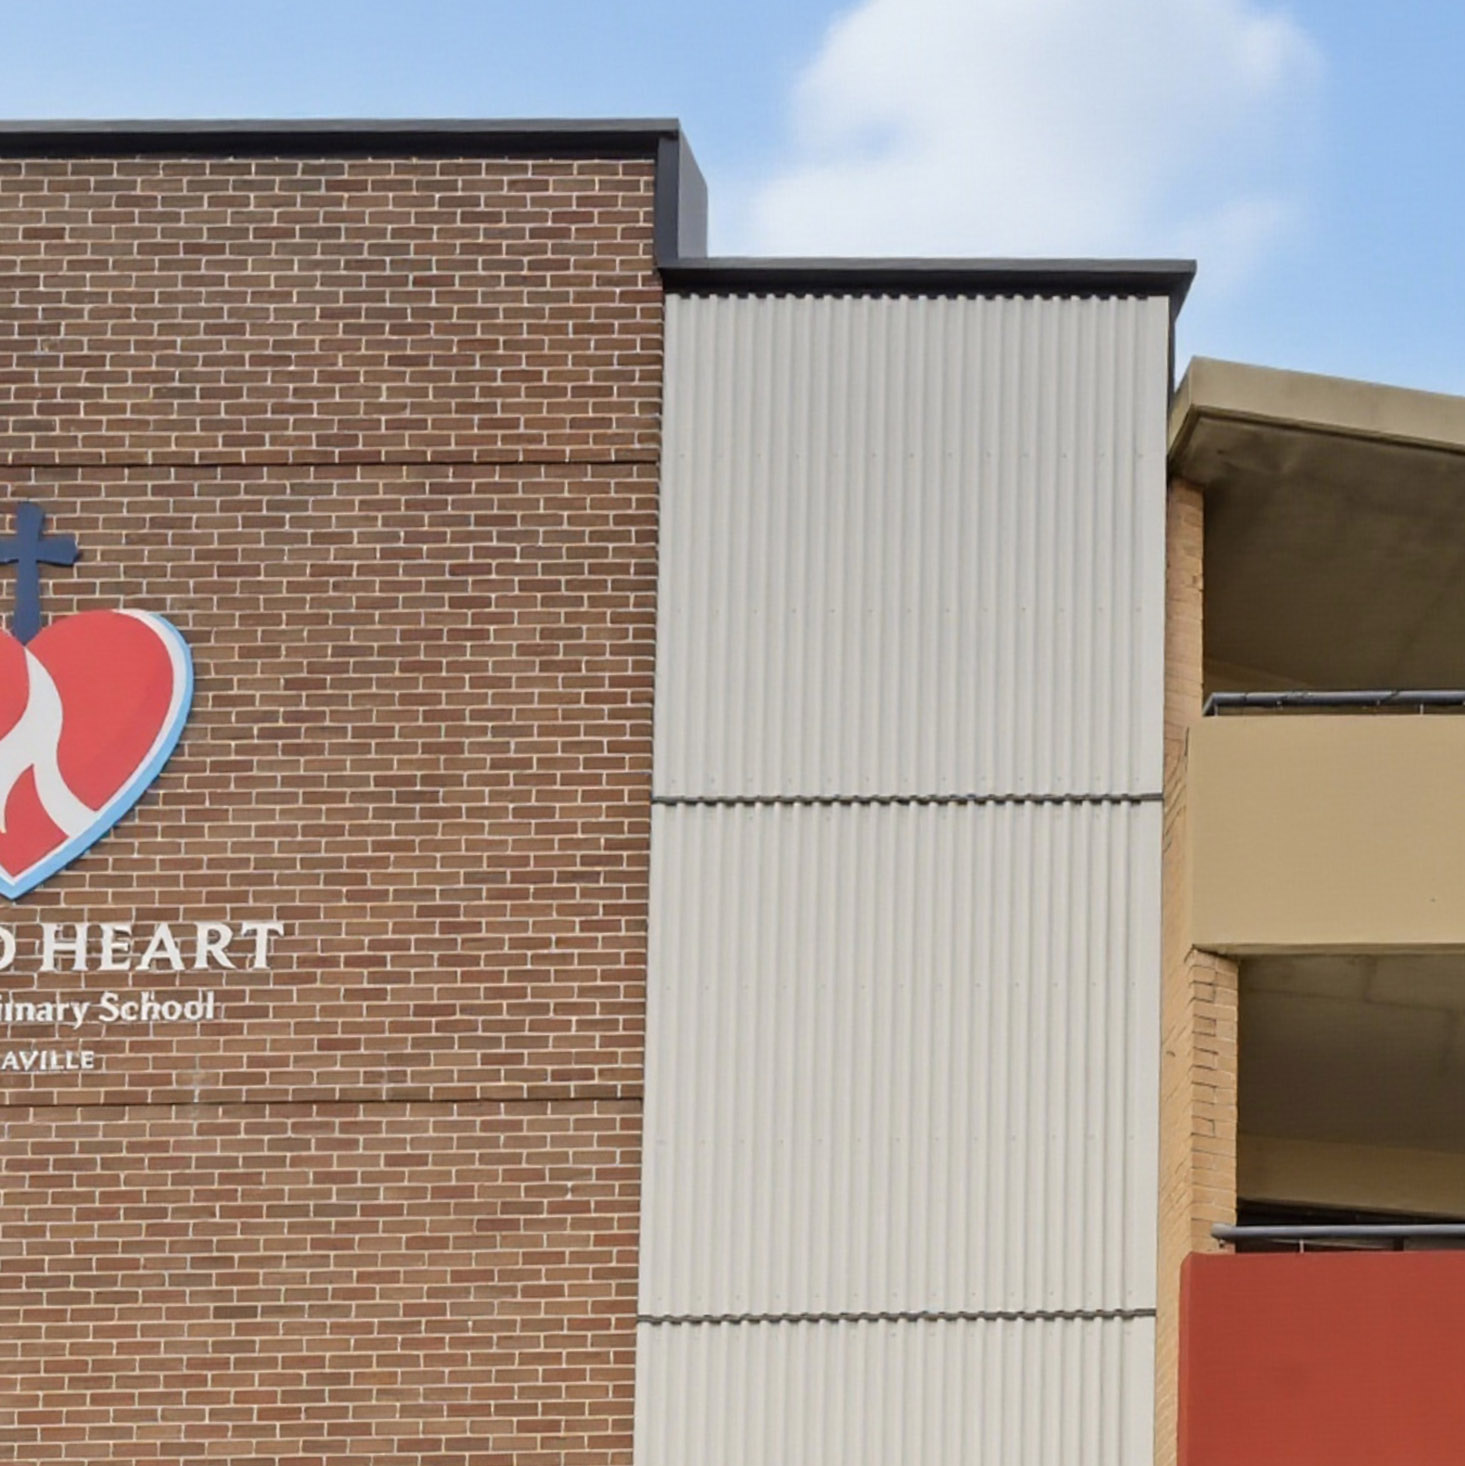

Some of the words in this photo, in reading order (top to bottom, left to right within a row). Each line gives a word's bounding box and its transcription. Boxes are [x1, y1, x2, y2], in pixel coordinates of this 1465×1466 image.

[39, 921, 285, 972] HEART
[98, 990, 215, 1022] School
[1, 1050, 95, 1071] AVILLE
